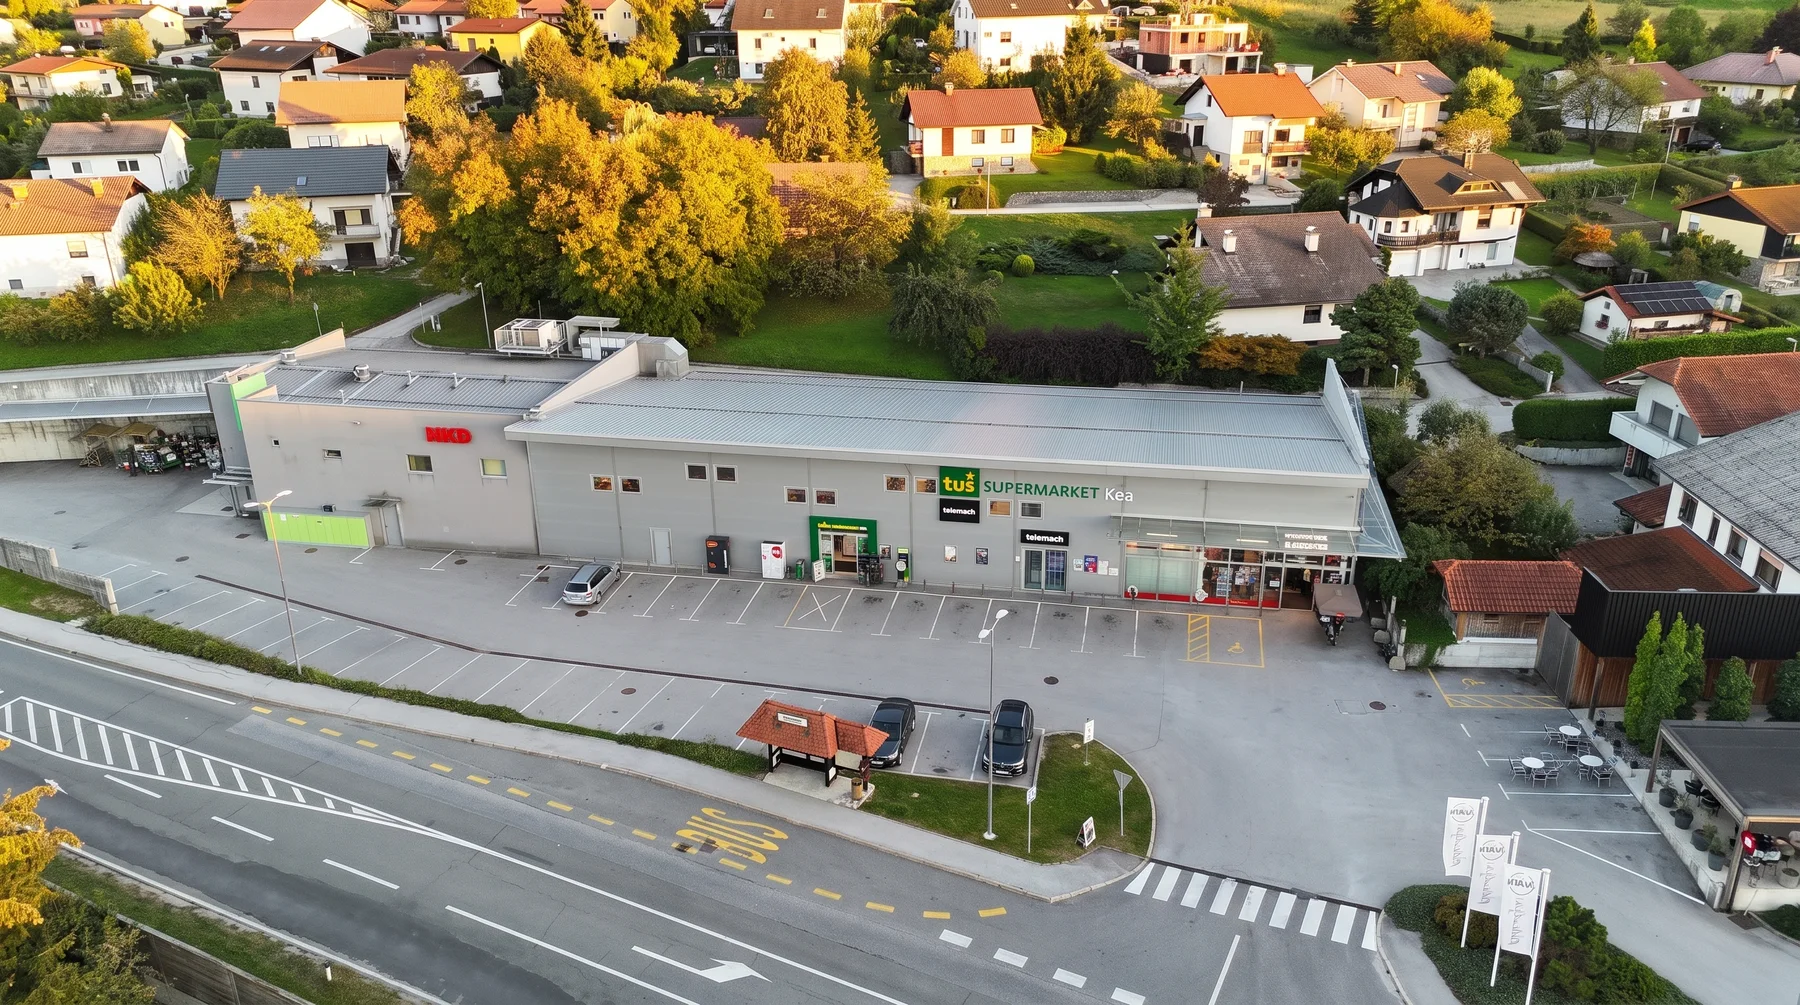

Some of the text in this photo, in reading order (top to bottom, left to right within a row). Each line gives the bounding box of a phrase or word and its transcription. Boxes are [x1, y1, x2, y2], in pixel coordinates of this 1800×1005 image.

[983, 480, 1100, 499] SUPERMARKET
[1105, 487, 1134, 502] Kea
[942, 507, 976, 515] telemach
[1025, 533, 1064, 543] telemach
[675, 807, 789, 865] BUS
